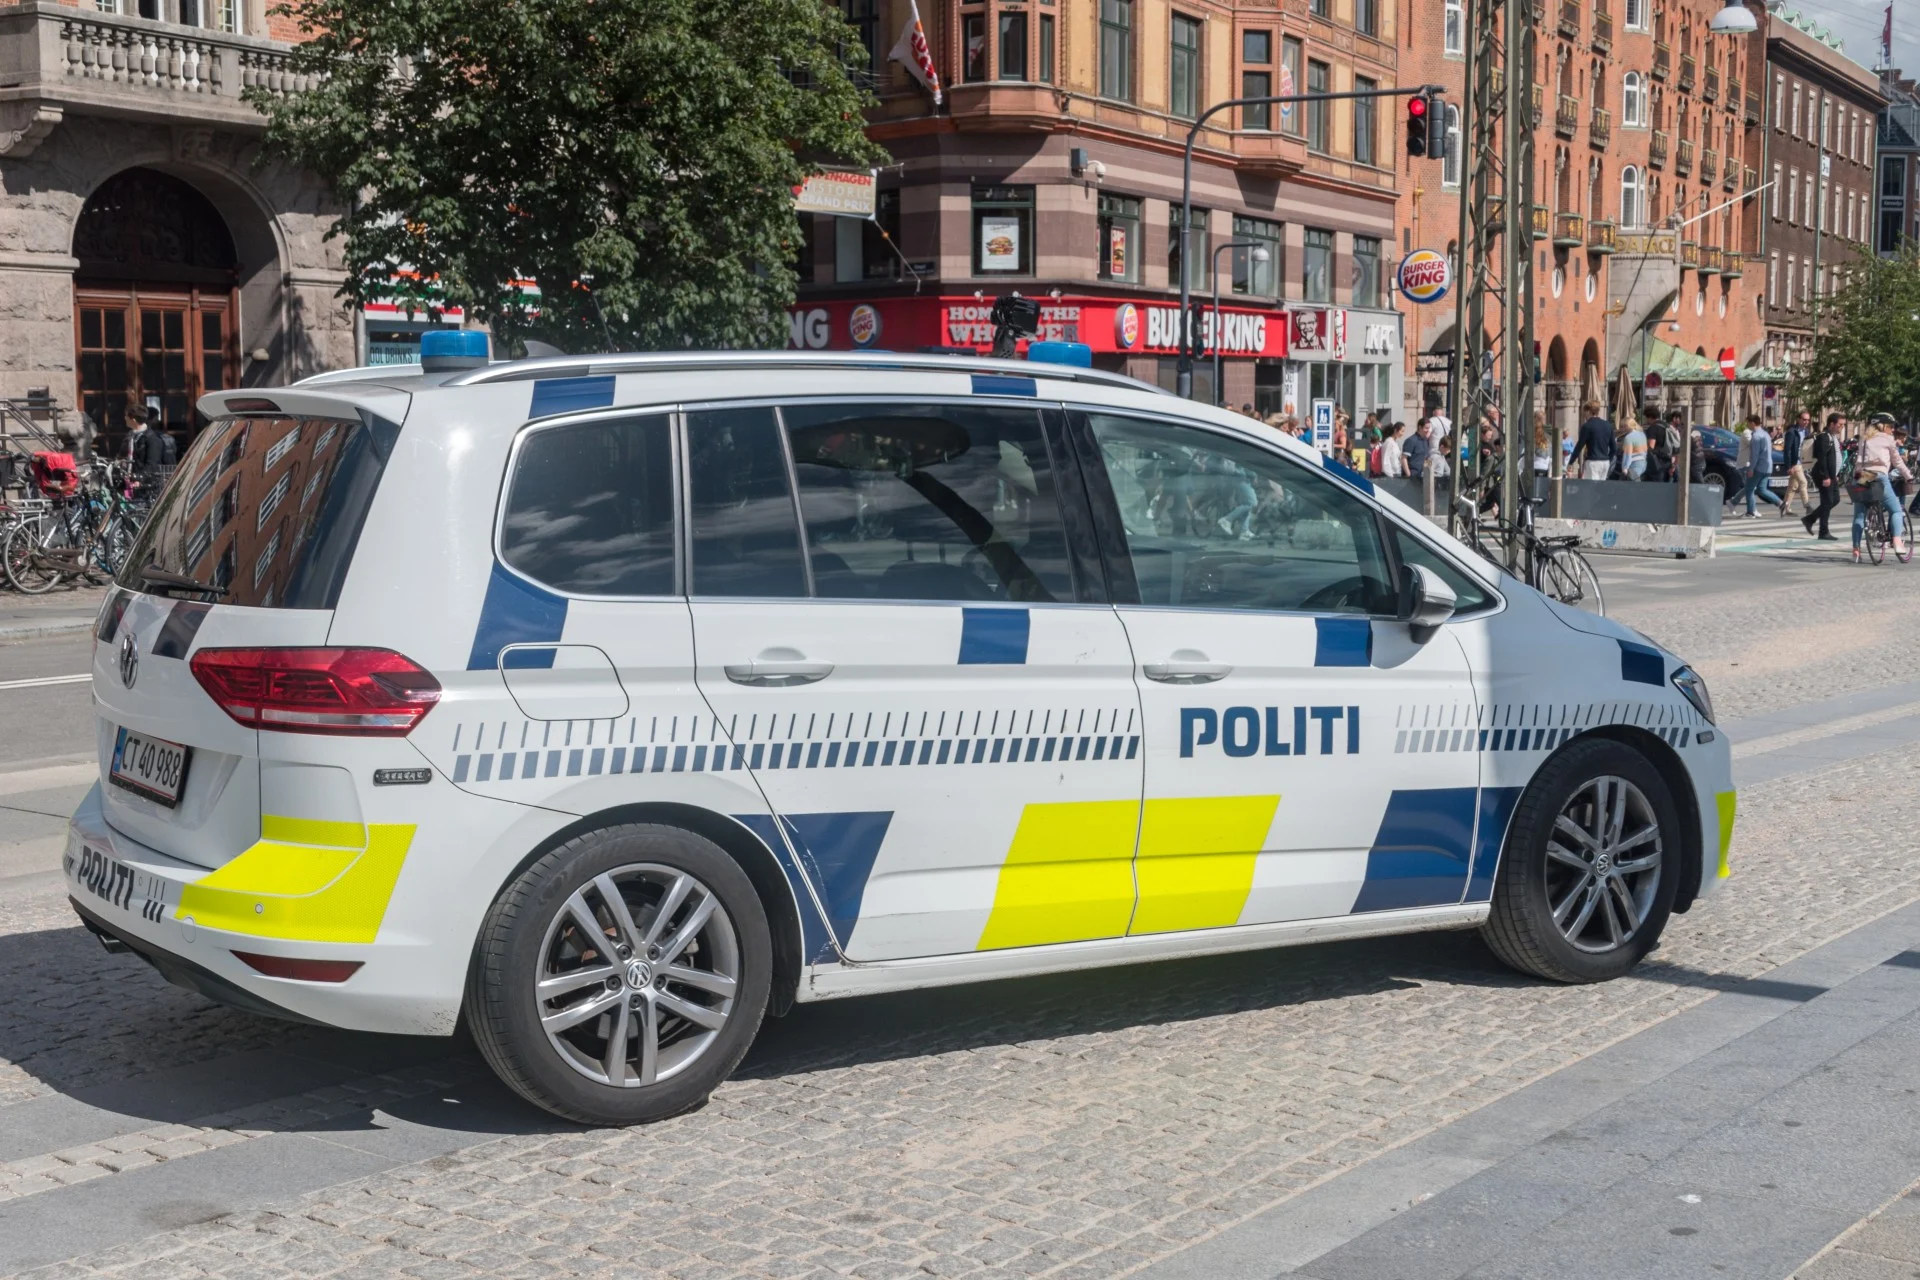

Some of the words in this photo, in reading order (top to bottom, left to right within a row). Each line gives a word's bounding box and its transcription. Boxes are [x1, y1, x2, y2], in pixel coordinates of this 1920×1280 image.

[801, 194, 840, 208] GRAND
[844, 199, 870, 212] PRIX
[1403, 261, 1444, 276] BURGER
[1403, 270, 1444, 290] KING
[949, 306, 993, 321] HOM
[1040, 306, 1080, 321] THE
[853, 321, 873, 336] KING
[1224, 312, 1266, 352] KING
[1366, 323, 1395, 350] KFC
[1179, 705, 1360, 758] POLITI
[122, 736, 140, 772] CT
[138, 743, 156, 779] 40
[155, 749, 181, 788] 988
[77, 845, 135, 911] POLITI
